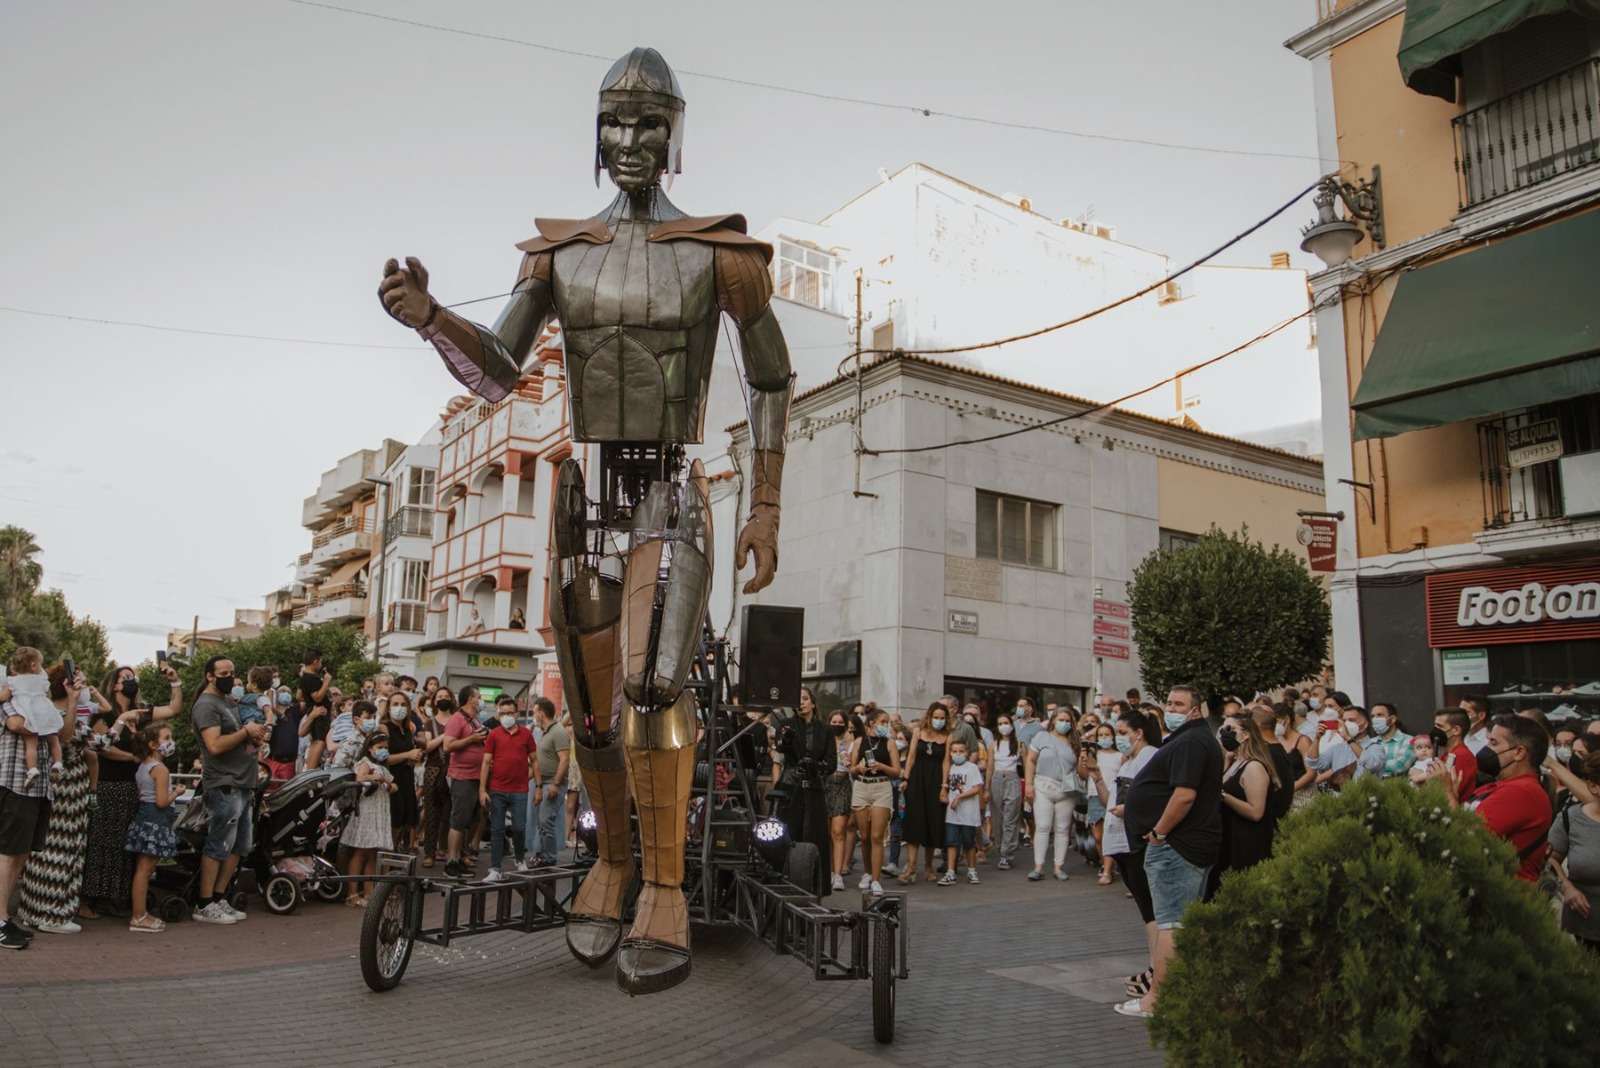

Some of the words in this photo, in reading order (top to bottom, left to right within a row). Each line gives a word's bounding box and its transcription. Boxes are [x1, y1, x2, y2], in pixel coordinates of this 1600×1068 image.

[1509, 431, 1518, 446] SE
[1520, 422, 1557, 444] ALQUILA
[1459, 584, 1541, 624] Foot
[482, 657, 515, 668] ONCE
